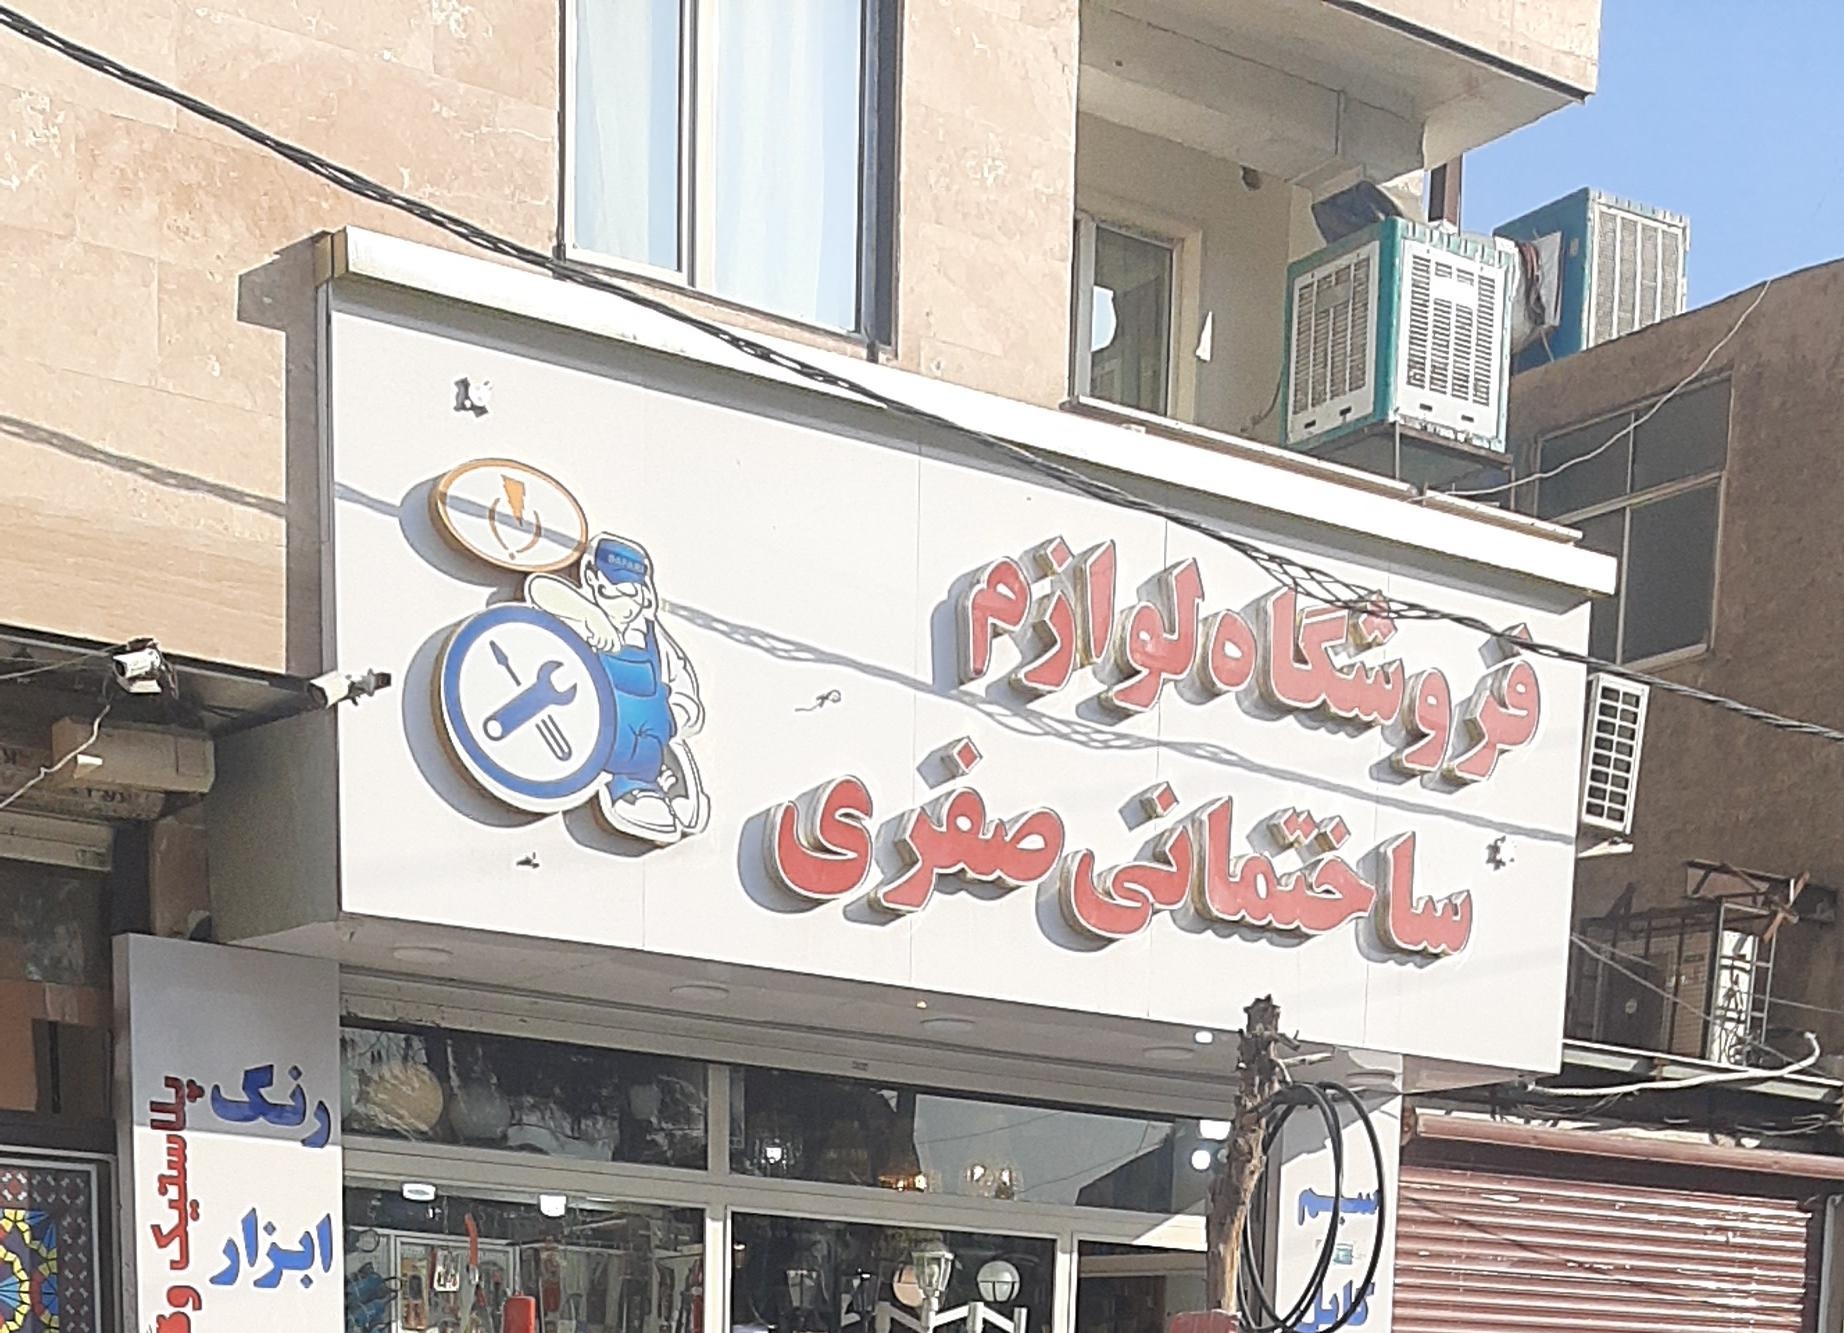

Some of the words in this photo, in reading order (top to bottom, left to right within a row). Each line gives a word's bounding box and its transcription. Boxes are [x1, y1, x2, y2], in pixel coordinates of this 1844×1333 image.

[968, 536, 1206, 712] لوازم
[1205, 584, 1542, 784] فروشگاه
[774, 733, 1064, 912] صفری
[1065, 780, 1474, 958] ساختمانی
[150, 1075, 206, 1271] پلاستیک
[209, 1207, 334, 1289] ابزار
